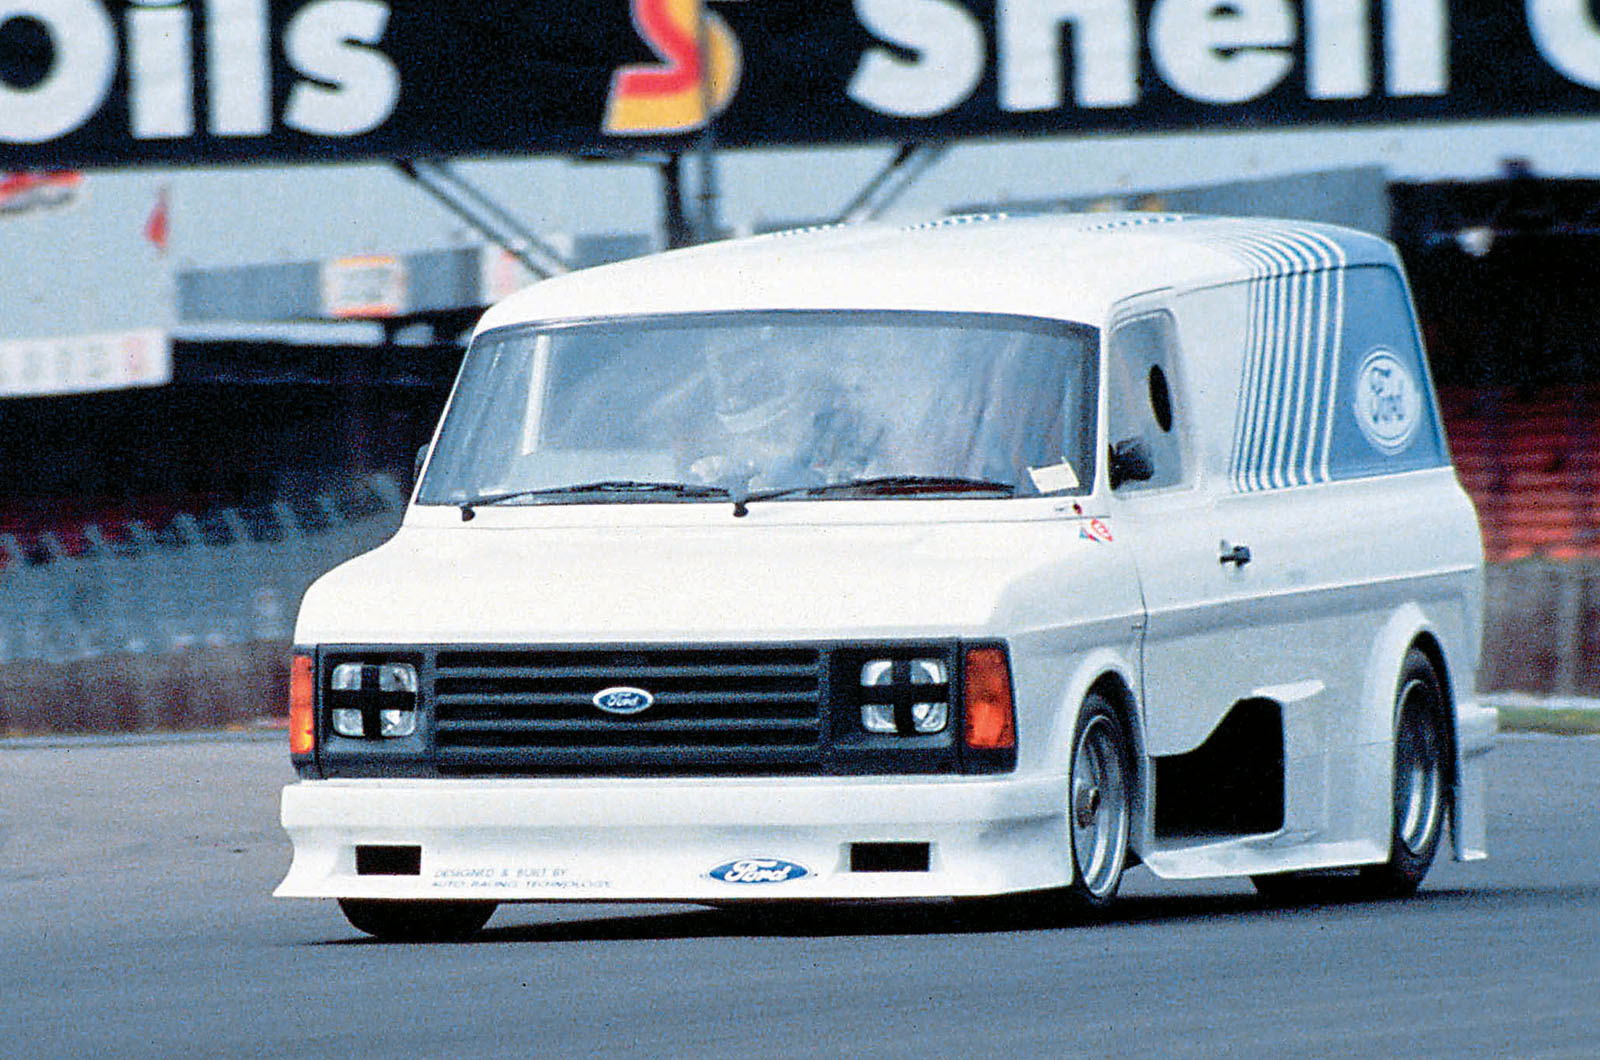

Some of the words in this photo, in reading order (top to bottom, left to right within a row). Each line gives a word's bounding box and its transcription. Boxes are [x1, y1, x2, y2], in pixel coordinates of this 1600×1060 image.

[0, 0, 401, 143] Oils
[606, 691, 641, 707] Ford
[433, 868, 495, 878] DESIGNED
[516, 867, 547, 878] BUILT
[552, 867, 567, 877] BY
[723, 860, 792, 882] Ford
